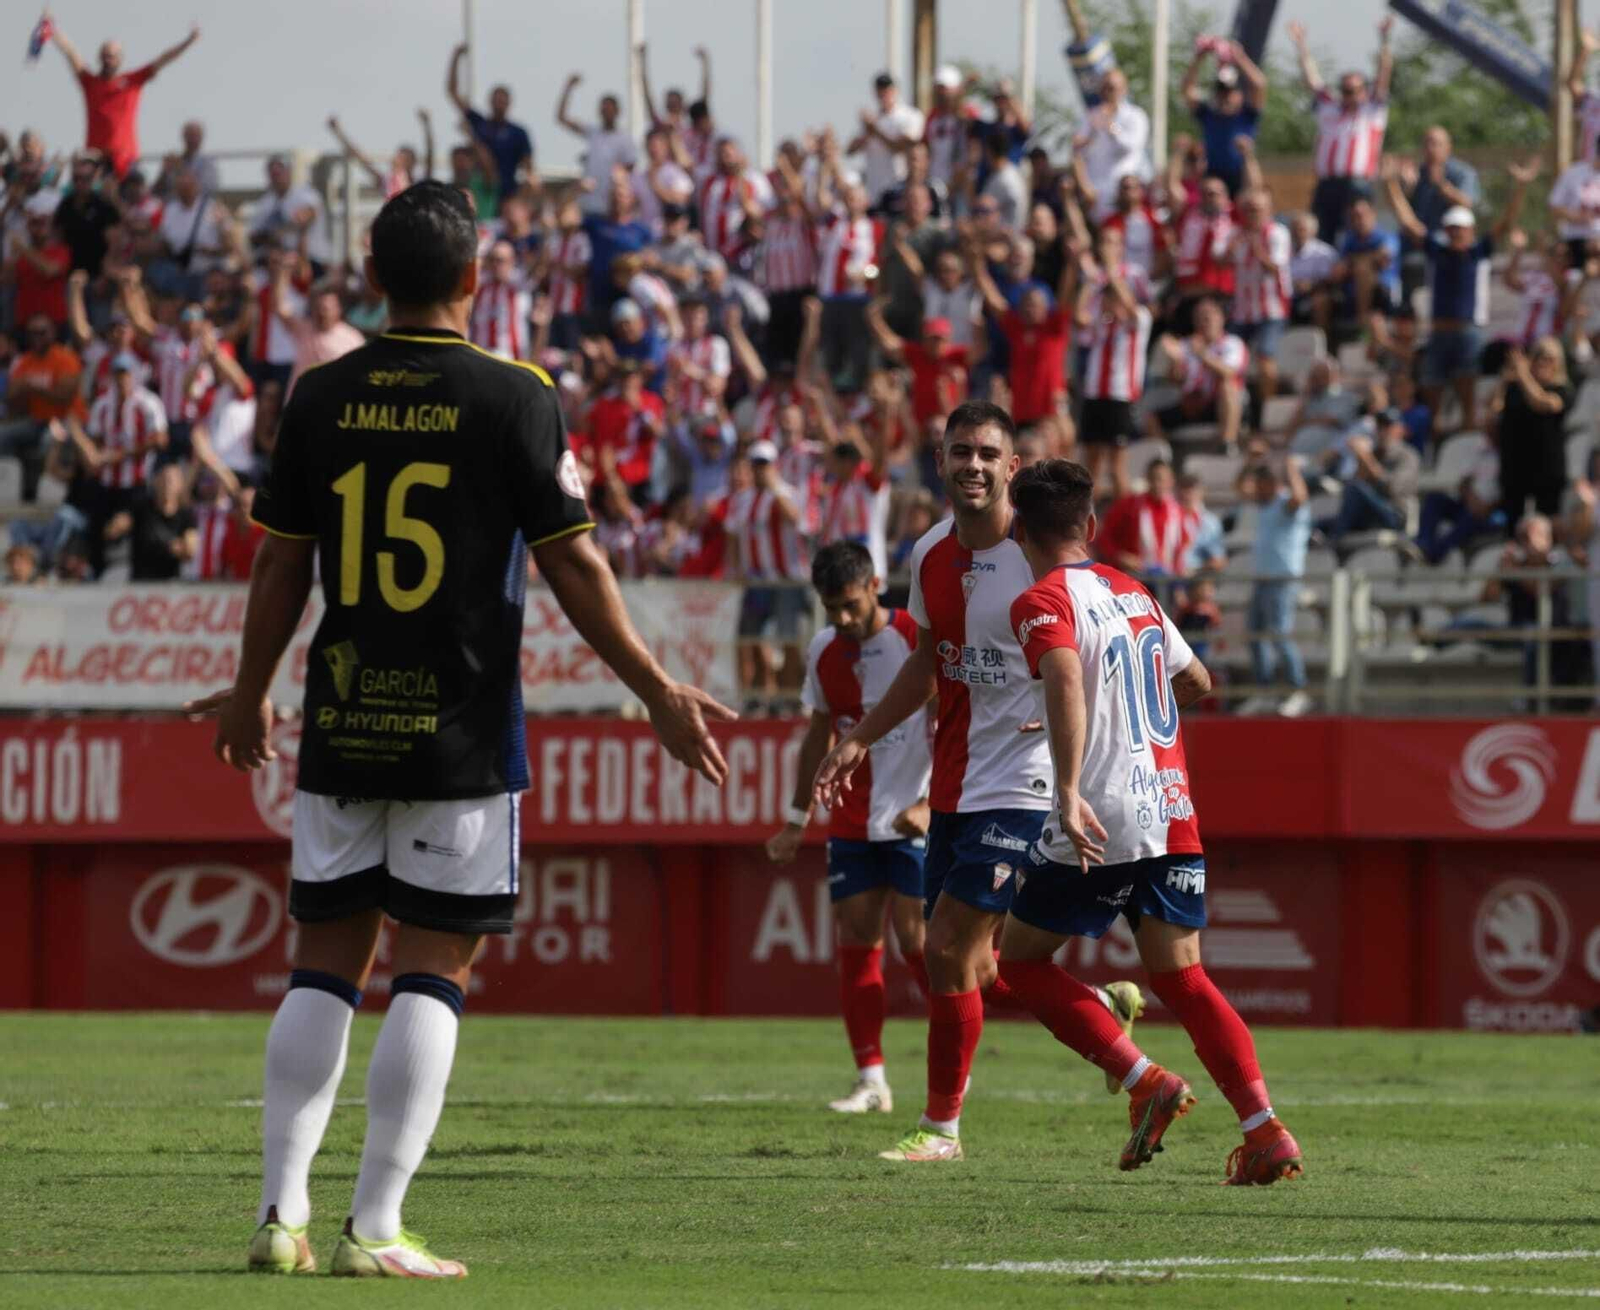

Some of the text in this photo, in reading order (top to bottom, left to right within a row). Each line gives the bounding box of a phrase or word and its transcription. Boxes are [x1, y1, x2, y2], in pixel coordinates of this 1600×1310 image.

[332, 461, 451, 612] 15
[22, 643, 240, 685] ALGECIRA
[360, 666, 439, 698] GARCÍA
[1101, 625, 1179, 753] 10
[344, 711, 438, 733] HYUNDAI
[540, 723, 832, 825] FEDERACIÓ
